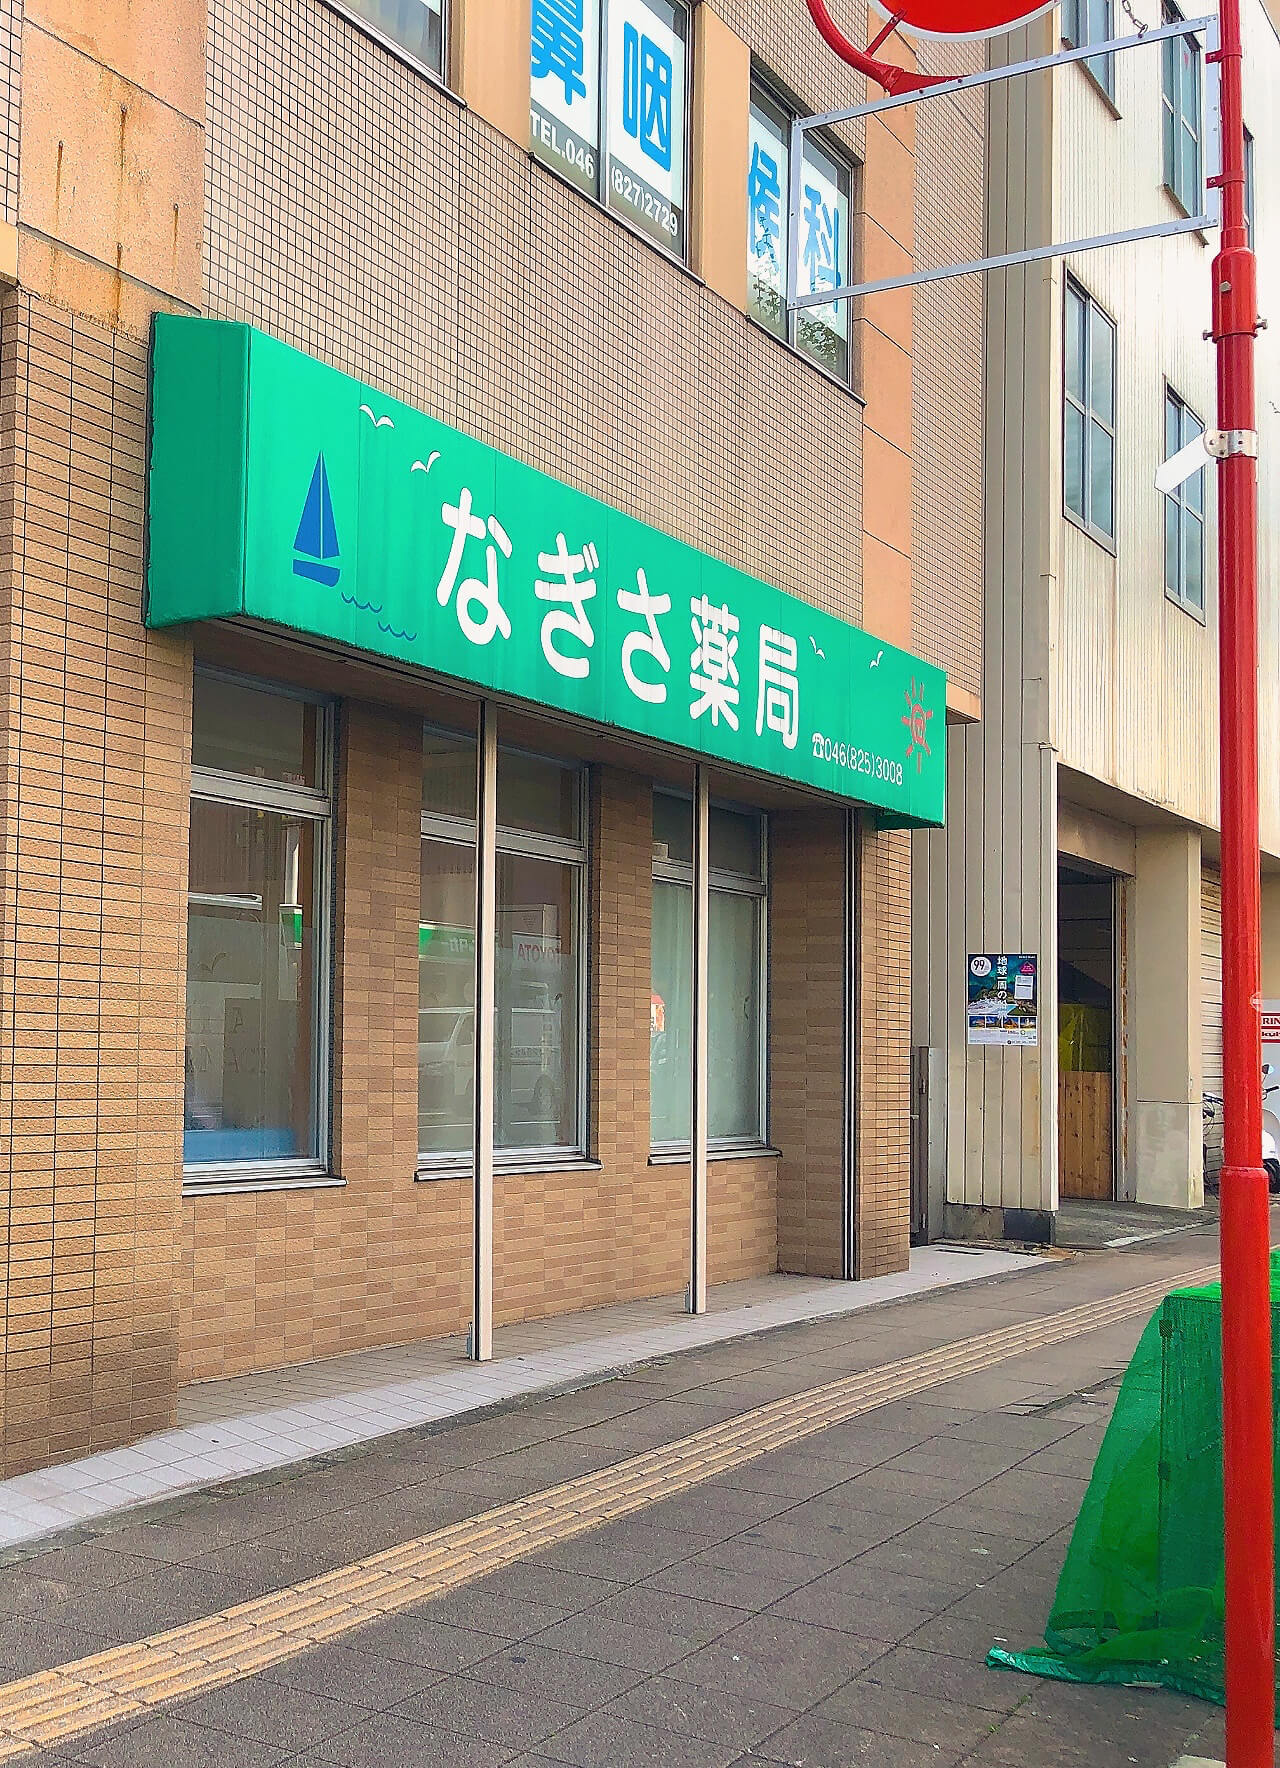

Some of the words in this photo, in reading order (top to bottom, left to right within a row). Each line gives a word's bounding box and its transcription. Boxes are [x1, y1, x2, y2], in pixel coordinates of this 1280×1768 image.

[530, 108, 595, 180] TEL.046
[610, 165, 679, 237] (827)2729
[436, 487, 800, 751] なぎさ薬局
[997, 955, 1008, 1021] 地球一周の
